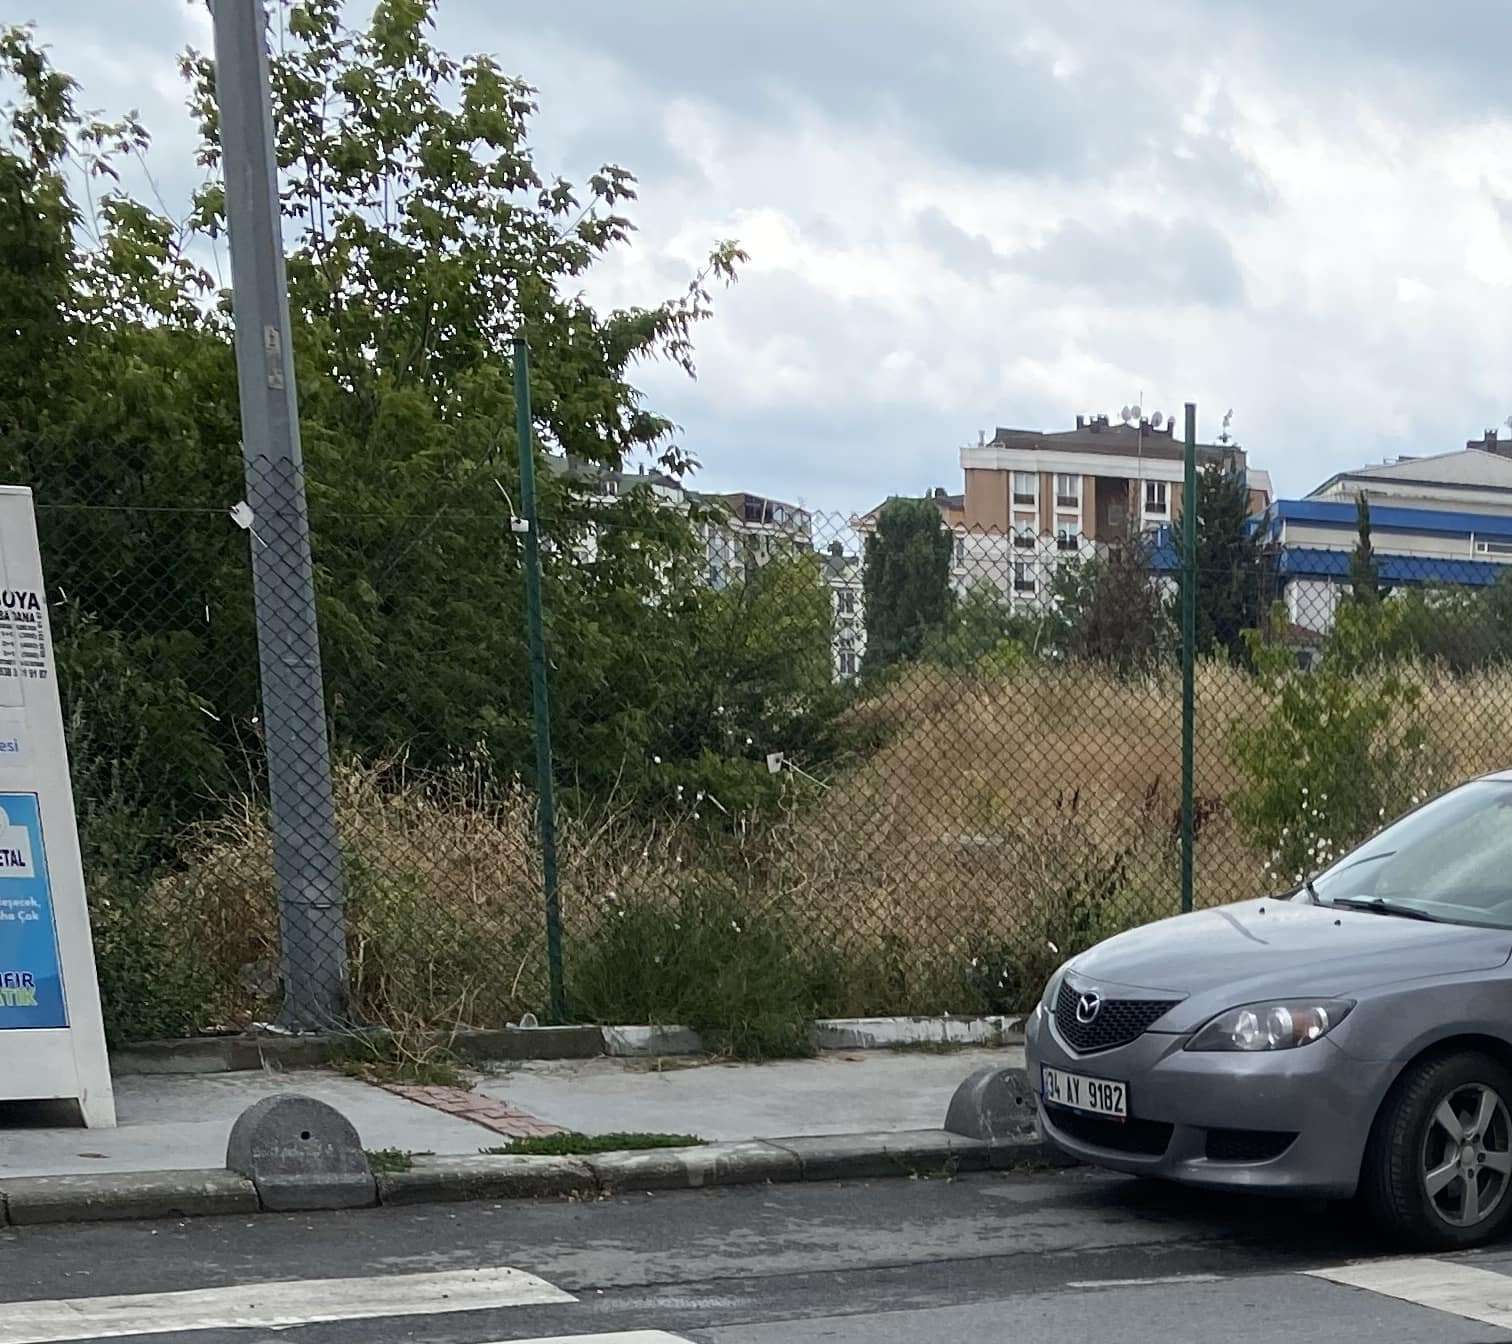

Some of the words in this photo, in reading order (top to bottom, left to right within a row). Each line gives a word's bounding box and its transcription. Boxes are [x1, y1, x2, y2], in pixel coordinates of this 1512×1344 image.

[0, 590, 41, 610] OYA
[1047, 1071, 1060, 1099] 34
[1067, 1076, 1080, 1104] AY
[1088, 1081, 1124, 1113] 9182
